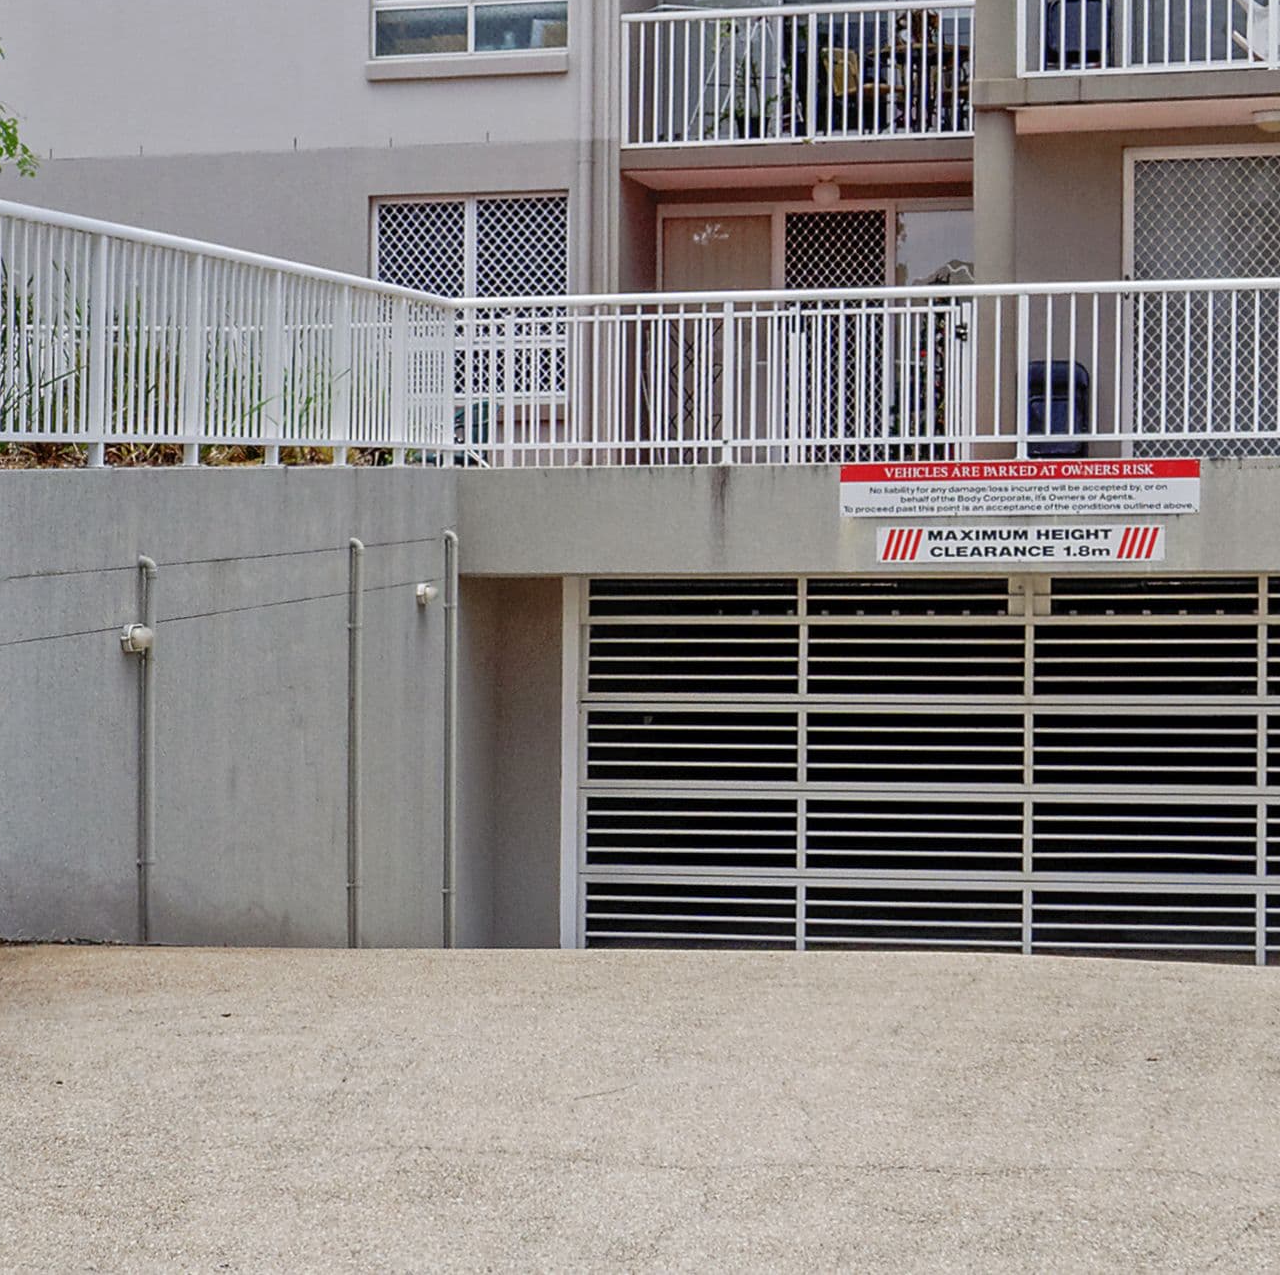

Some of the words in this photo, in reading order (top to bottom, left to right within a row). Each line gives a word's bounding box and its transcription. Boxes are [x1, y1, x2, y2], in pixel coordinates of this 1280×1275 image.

[884, 466, 948, 478] VEHICLES
[951, 466, 980, 478] ARE
[983, 465, 1037, 477] PARKED
[1040, 465, 1057, 476] AT
[1061, 464, 1120, 476] OWNERS
[1122, 463, 1154, 475] RISK
[869, 486, 882, 494] No
[884, 486, 915, 495] liability
[916, 486, 929, 494] for
[930, 487, 946, 495] any
[1011, 485, 1050, 493] incurred
[1052, 484, 1066, 492] will
[1068, 484, 1080, 492] be
[1082, 484, 1128, 493] accepted
[900, 496, 929, 504] behalf
[930, 495, 940, 503] of
[941, 495, 955, 503] the
[957, 495, 981, 504] Body
[983, 494, 1034, 503] Corporate,
[1049, 493, 1086, 502] Owners
[843, 505, 854, 513] To
[855, 505, 894, 514] proceed
[896, 505, 917, 513] past
[919, 505, 935, 513] this
[937, 504, 960, 513] point
[986, 504, 1042, 512] acceptance
[1054, 503, 1070, 511] the
[1072, 502, 1121, 511] conditions
[1123, 502, 1161, 510] outlined
[928, 529, 1029, 541] MAXIMUM
[1036, 528, 1113, 541] HEIGHT
[930, 545, 1055, 558] CLEARANCE
[1063, 545, 1111, 557] 1.8m
